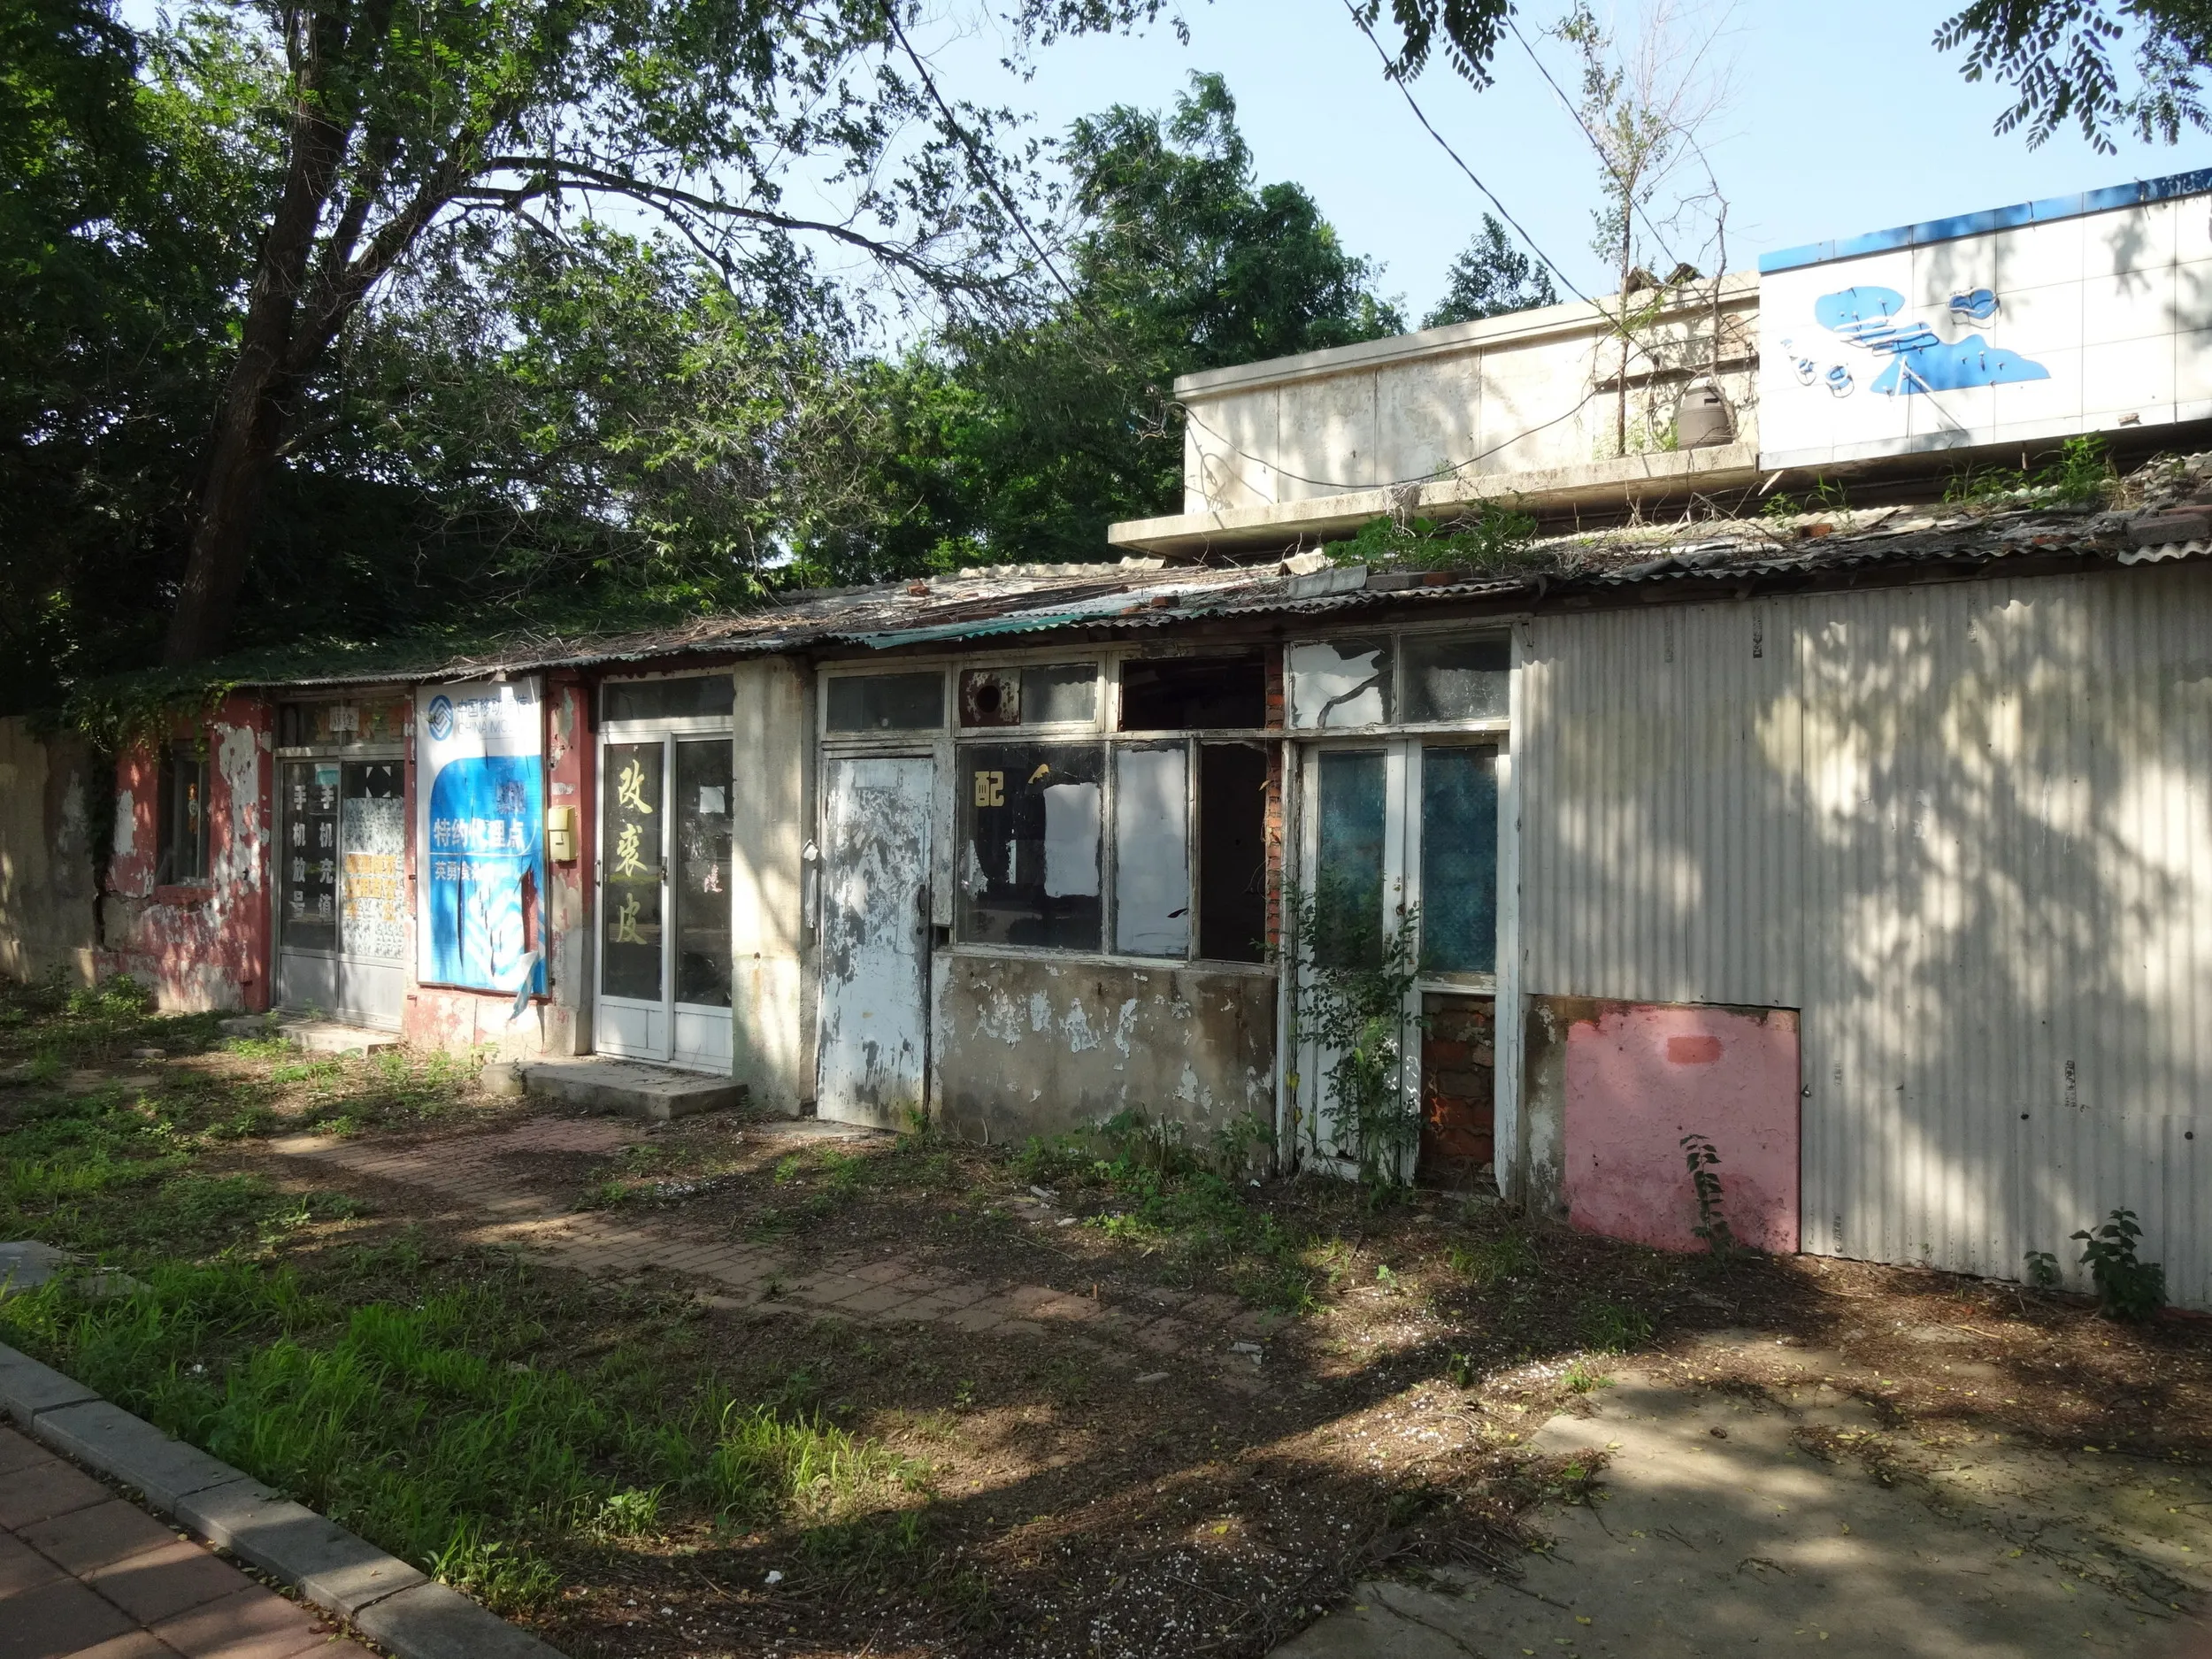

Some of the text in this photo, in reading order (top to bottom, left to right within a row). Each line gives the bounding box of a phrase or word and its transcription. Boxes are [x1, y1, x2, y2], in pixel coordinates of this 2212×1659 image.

[974, 770, 1004, 807] 配
[434, 817, 526, 851] 特约代理点
